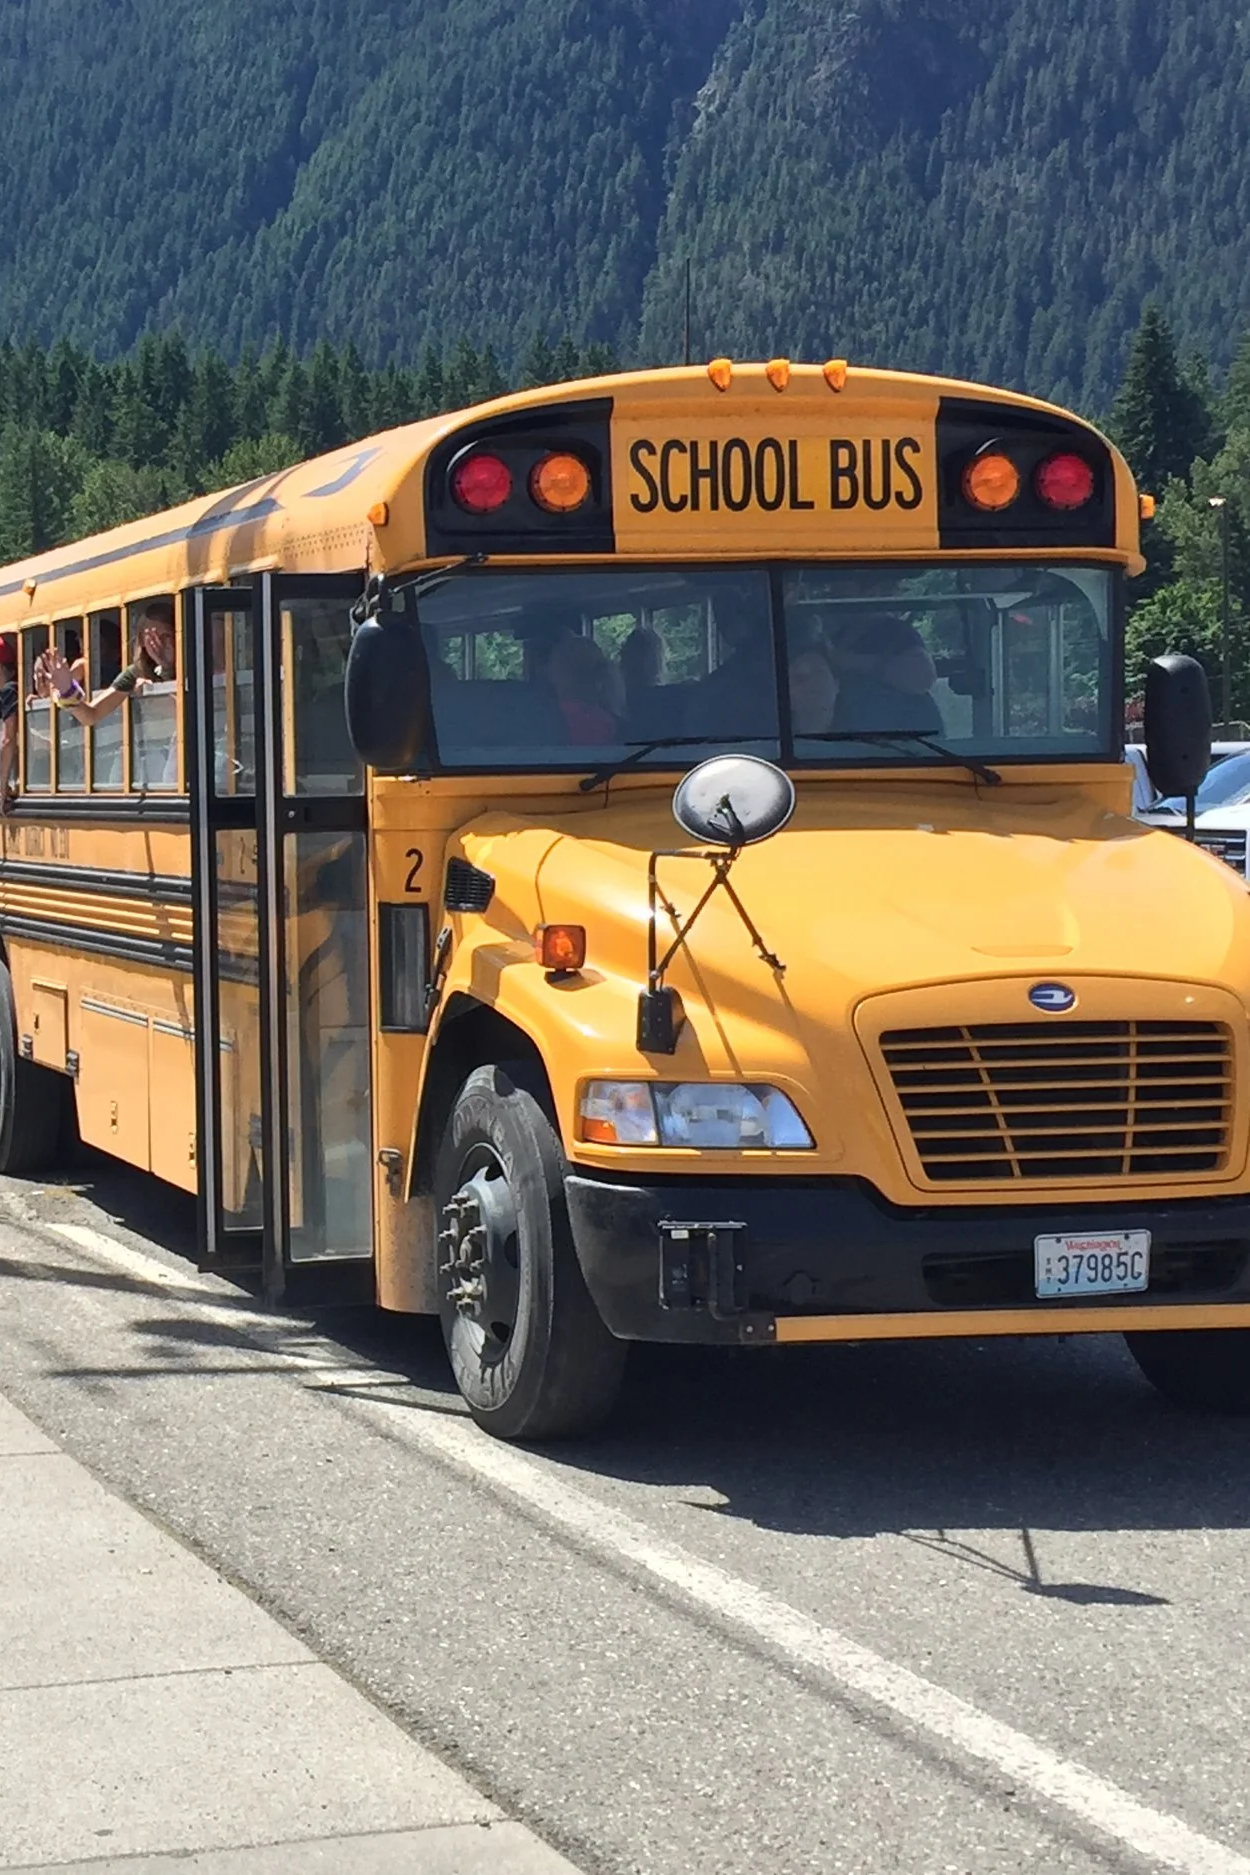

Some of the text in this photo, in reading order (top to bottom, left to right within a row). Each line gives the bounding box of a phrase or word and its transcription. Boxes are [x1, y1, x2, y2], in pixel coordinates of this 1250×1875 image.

[629, 436, 923, 513] SCHOOL BUS
[405, 848, 424, 893] 2
[1057, 1251, 1143, 1285] 37985C
